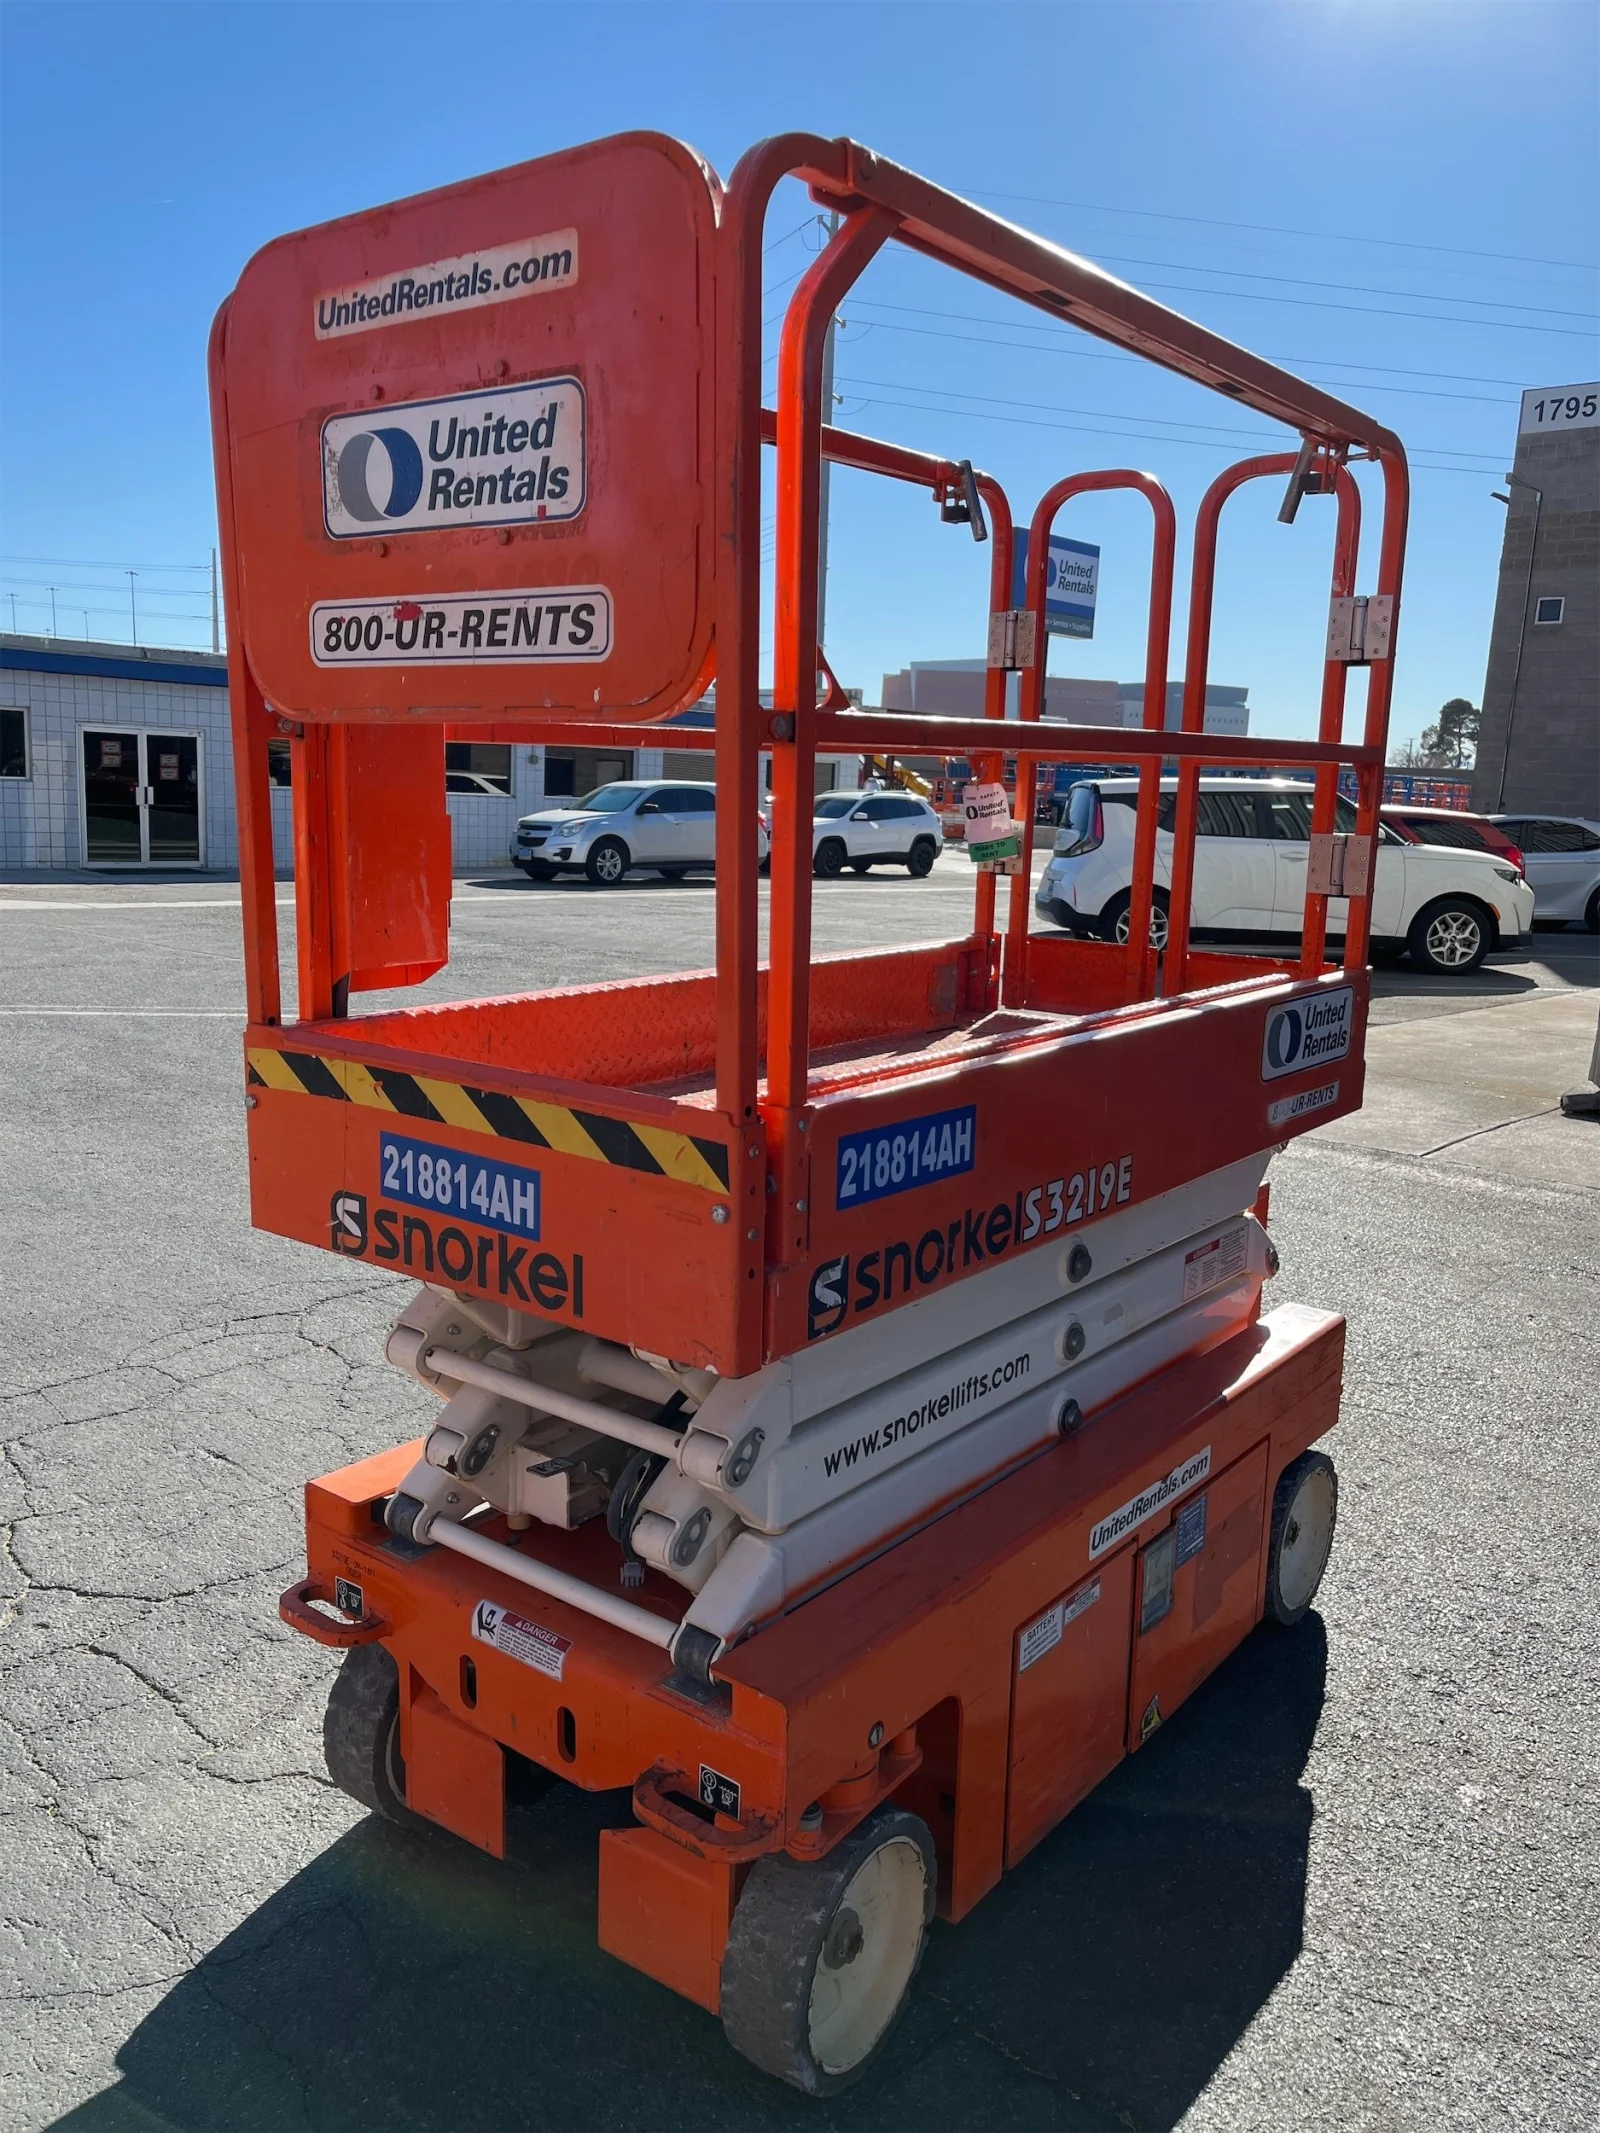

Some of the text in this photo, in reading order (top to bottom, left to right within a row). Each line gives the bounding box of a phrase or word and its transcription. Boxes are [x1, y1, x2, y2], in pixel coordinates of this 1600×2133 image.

[319, 248, 571, 330] UnitedRentals.com
[1534, 394, 1598, 422] 1795
[428, 402, 558, 461] United
[428, 456, 569, 511] Rentals
[1058, 576, 1094, 595] Rentals
[1059, 559, 1093, 579] United
[324, 602, 595, 653] 800-UR-RENTS
[978, 800, 1003, 812] United
[980, 807, 1007, 819] Rentals
[974, 843, 995, 852] READY
[981, 850, 1000, 859] RENT
[1305, 997, 1348, 1031] United
[1302, 1024, 1348, 1059] Rentals
[1272, 1084, 1335, 1120] 8-UR-RENTS
[839, 1118, 973, 1199] 218814AH
[382, 1144, 535, 1230] 218814AH
[854, 1191, 1024, 1312] snorkel
[1022, 1153, 1134, 1243] S3219E
[374, 1209, 584, 1318] snorkel
[822, 1351, 1031, 1477] www.snorkellifts.com
[1092, 1455, 1208, 1551] UnitedRentals.com
[522, 1622, 558, 1646] DANGER
[1027, 1612, 1056, 1642] BATTERY
